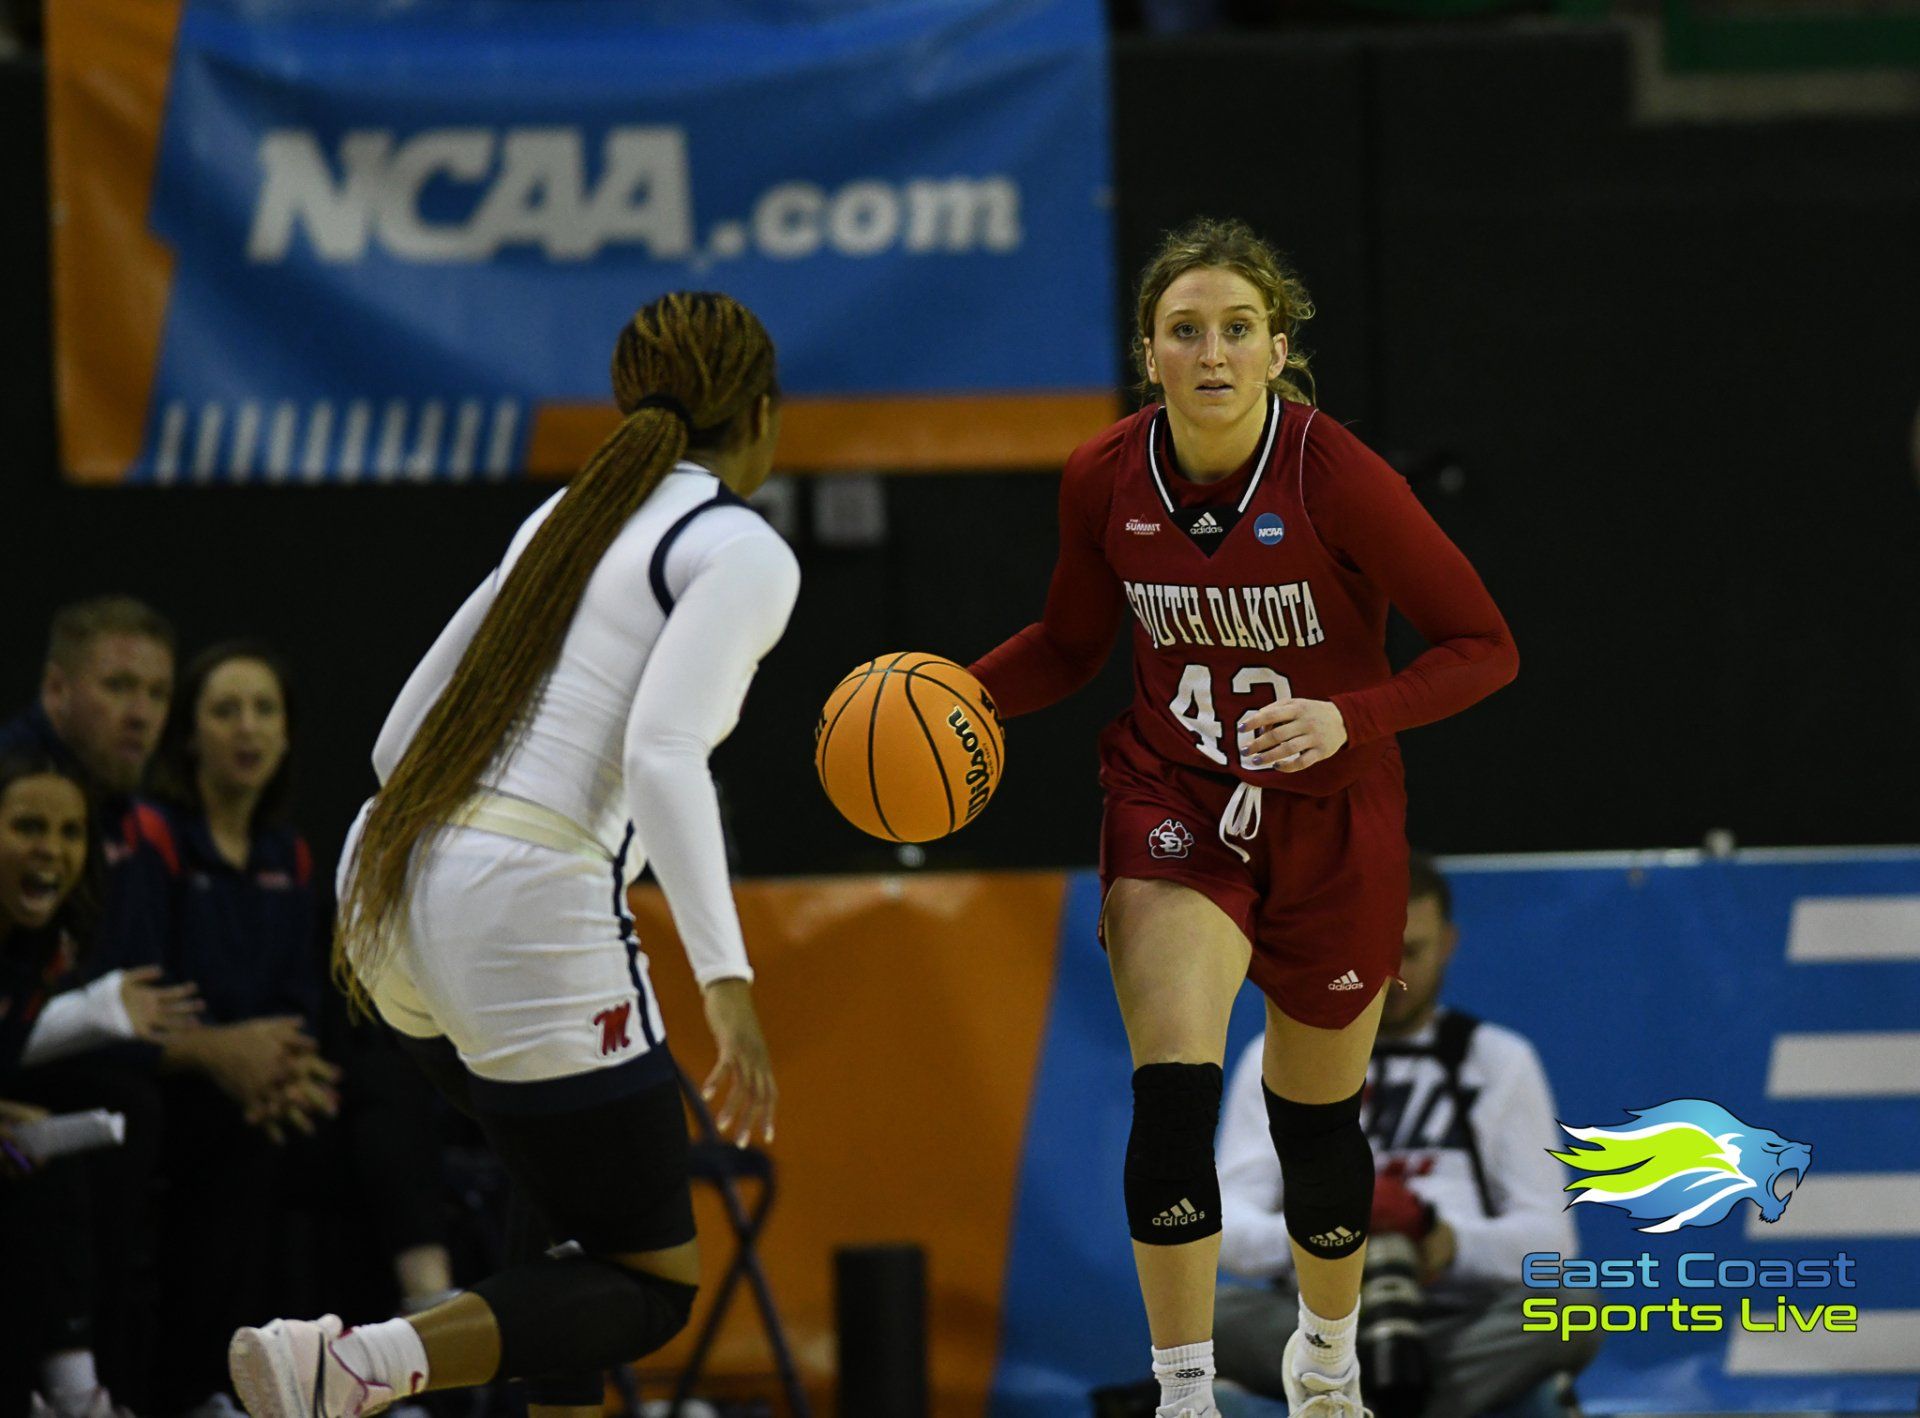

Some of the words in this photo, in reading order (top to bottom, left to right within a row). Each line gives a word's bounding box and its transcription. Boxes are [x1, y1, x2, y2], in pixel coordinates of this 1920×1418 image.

[247, 126, 1021, 263] NCAA.com
[1190, 525, 1223, 535] adidas
[1258, 527, 1283, 538] NCAA
[1206, 581, 1324, 652] DAKOTA
[1169, 664, 1300, 771] 42
[1328, 980, 1364, 991] adidas
[1152, 1207, 1206, 1227] adidas
[1309, 1229, 1361, 1248] adidas
